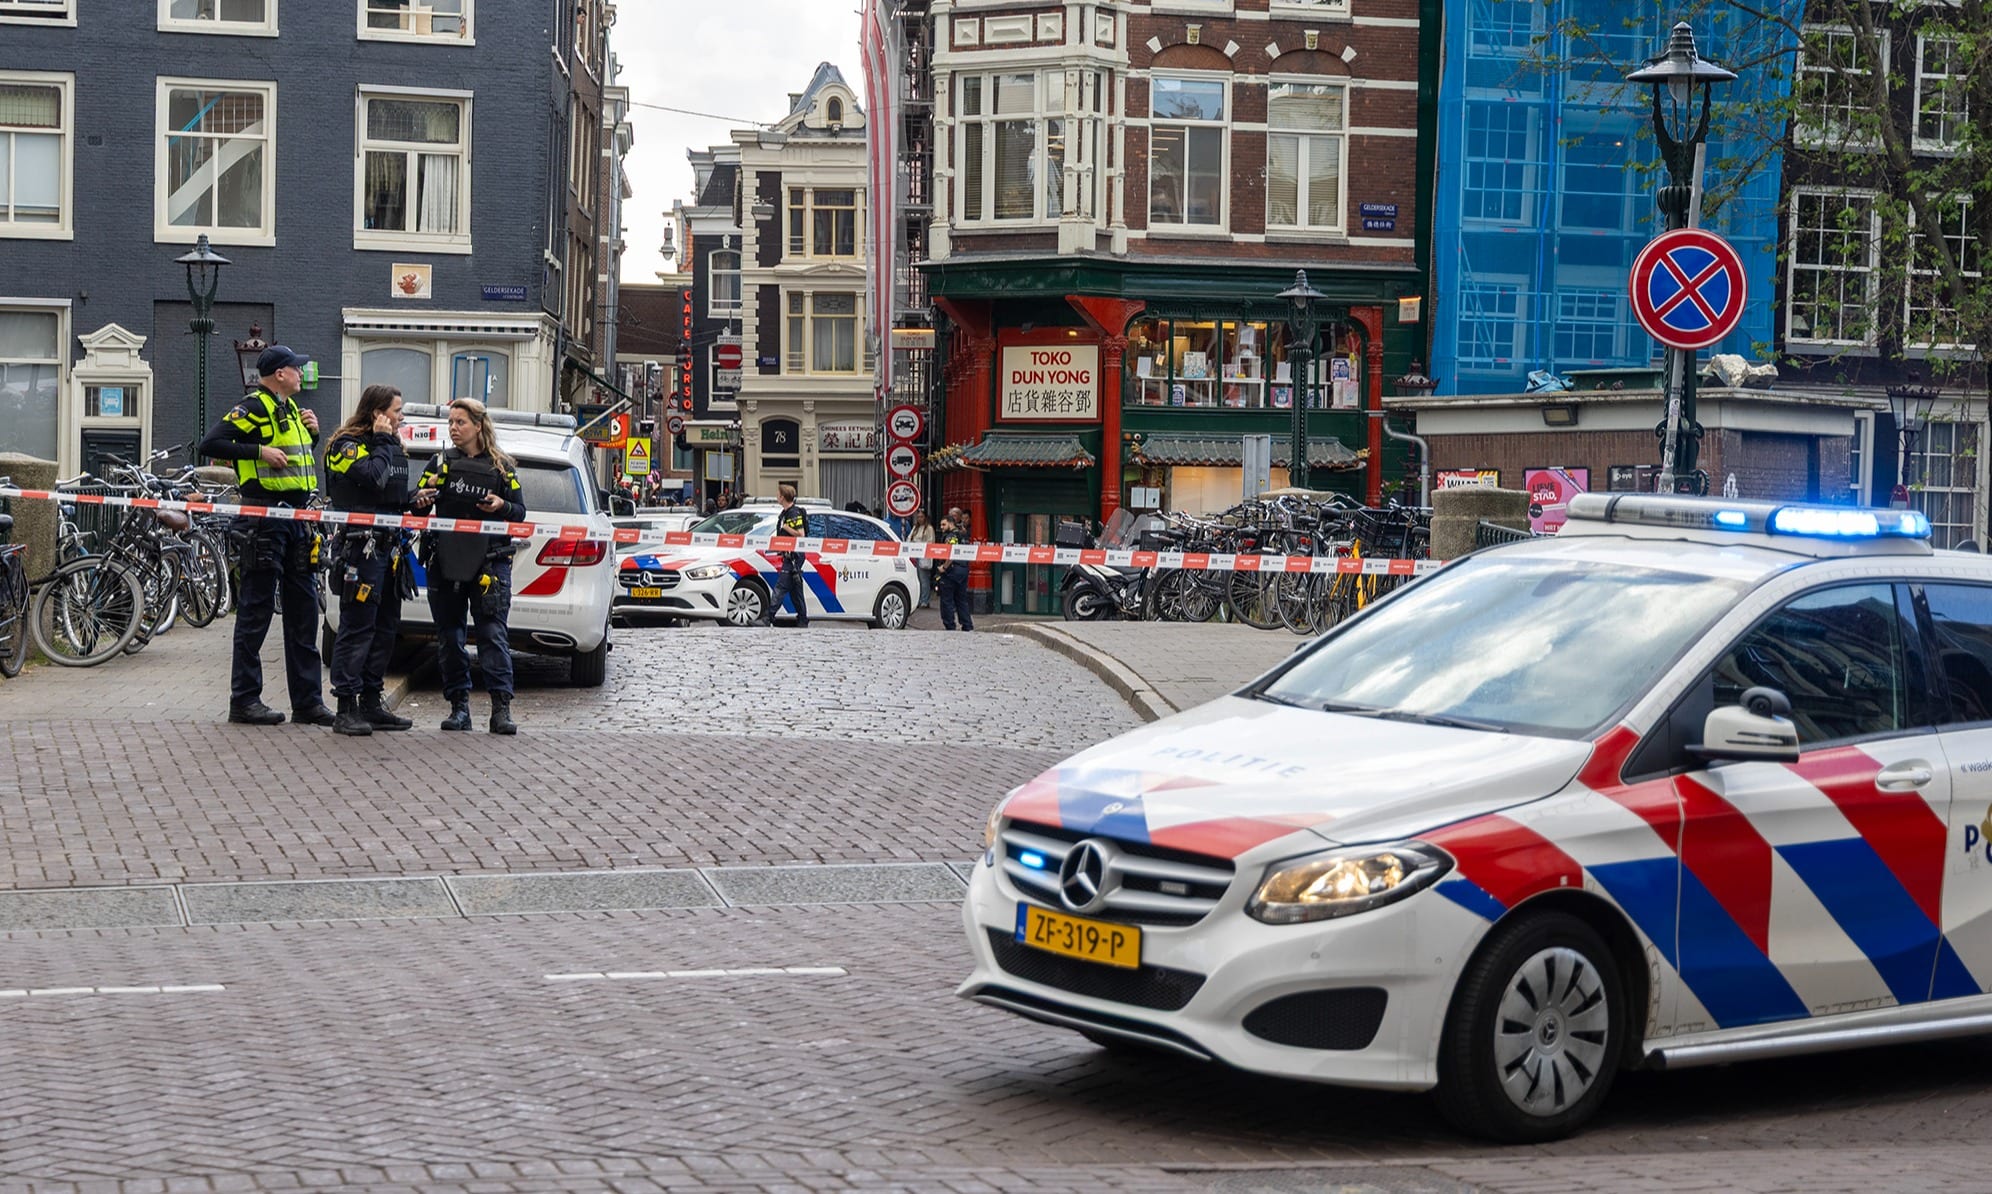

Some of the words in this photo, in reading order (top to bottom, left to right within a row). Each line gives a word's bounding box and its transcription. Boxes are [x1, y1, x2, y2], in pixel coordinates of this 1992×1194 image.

[1031, 351, 1071, 366] TOKO
[1012, 370, 1044, 384] DUN
[1047, 370, 1090, 384] YONG
[774, 431, 786, 443] 78
[838, 566, 869, 582] POLITIE
[1151, 747, 1305, 777] POLITIE
[1034, 914, 1125, 958] ZF-319-P
